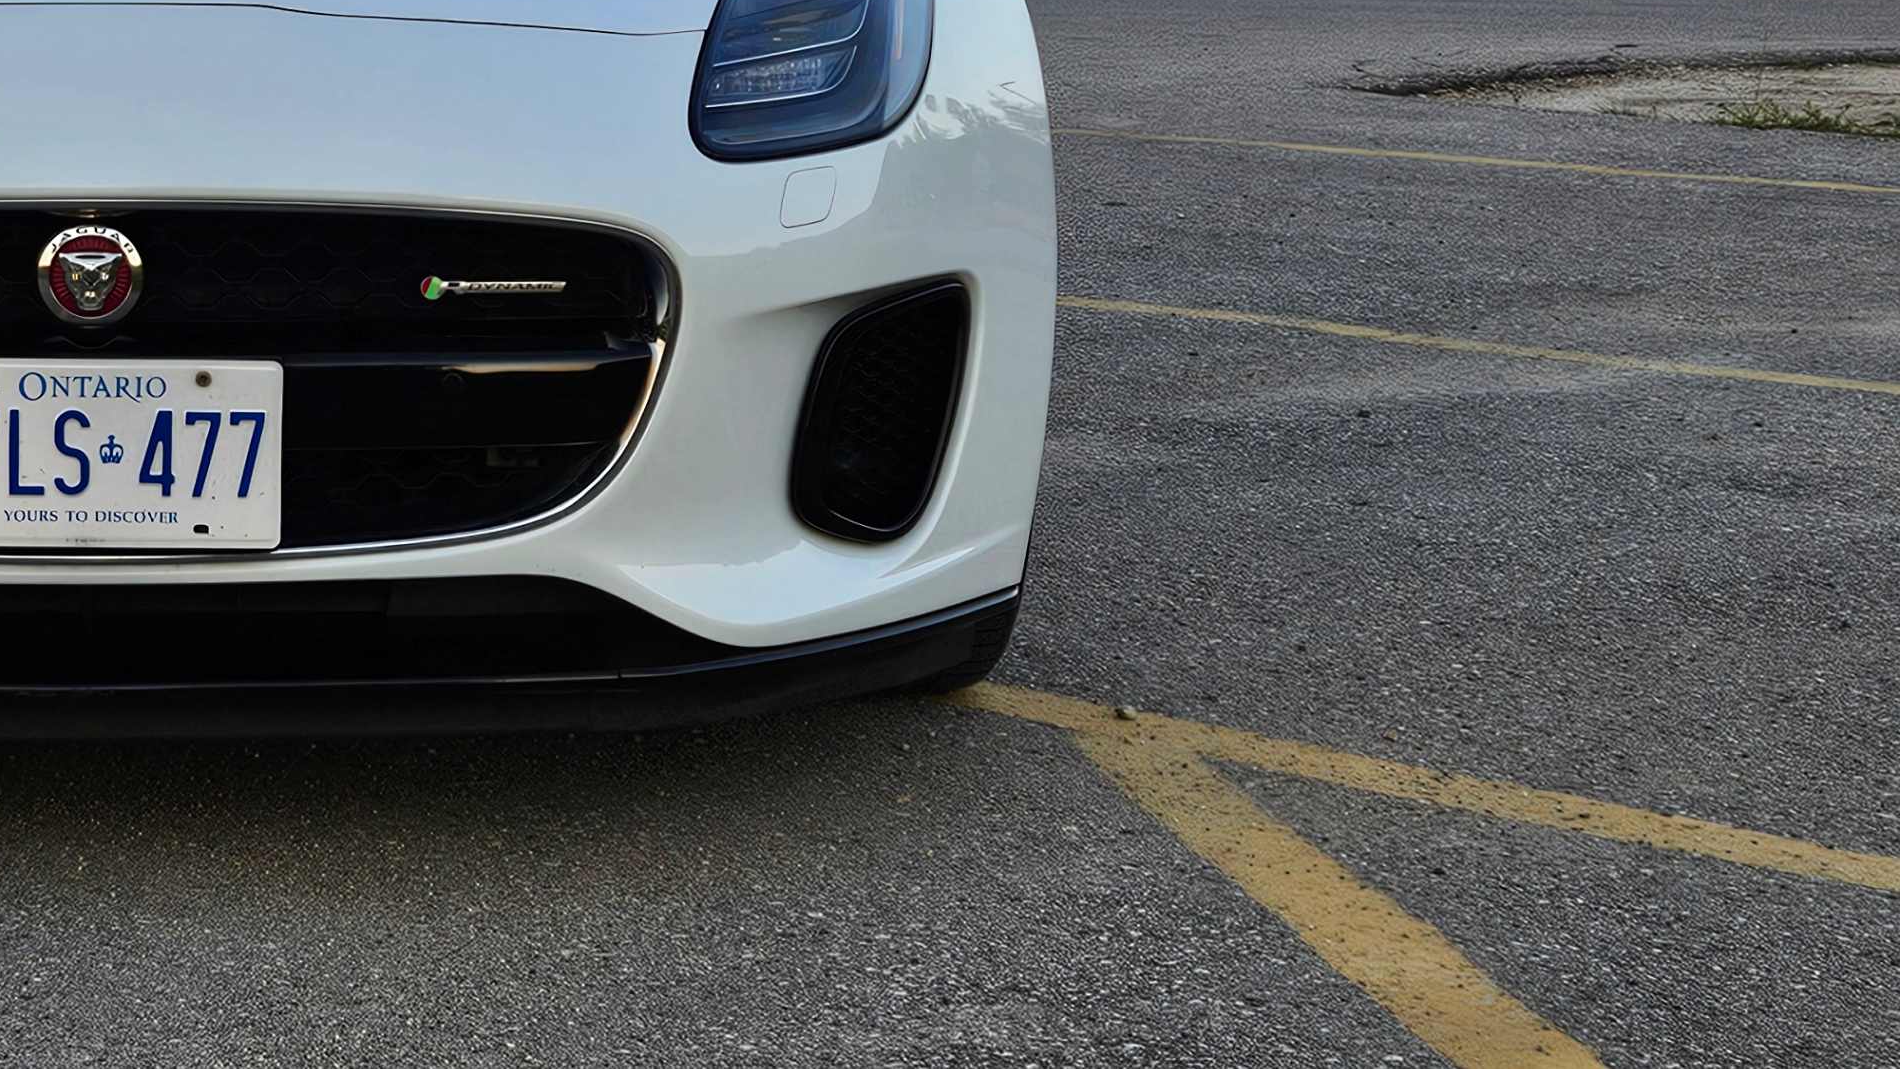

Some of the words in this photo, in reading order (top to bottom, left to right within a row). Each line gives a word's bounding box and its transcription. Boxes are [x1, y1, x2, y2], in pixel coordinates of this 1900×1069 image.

[49, 226, 135, 254] JAGUAR
[18, 371, 167, 403] ONTARIO
[138, 410, 266, 499] 477
[4, 509, 59, 523] YOURS
[66, 510, 89, 523] TO
[95, 510, 179, 524] DISCOVER
